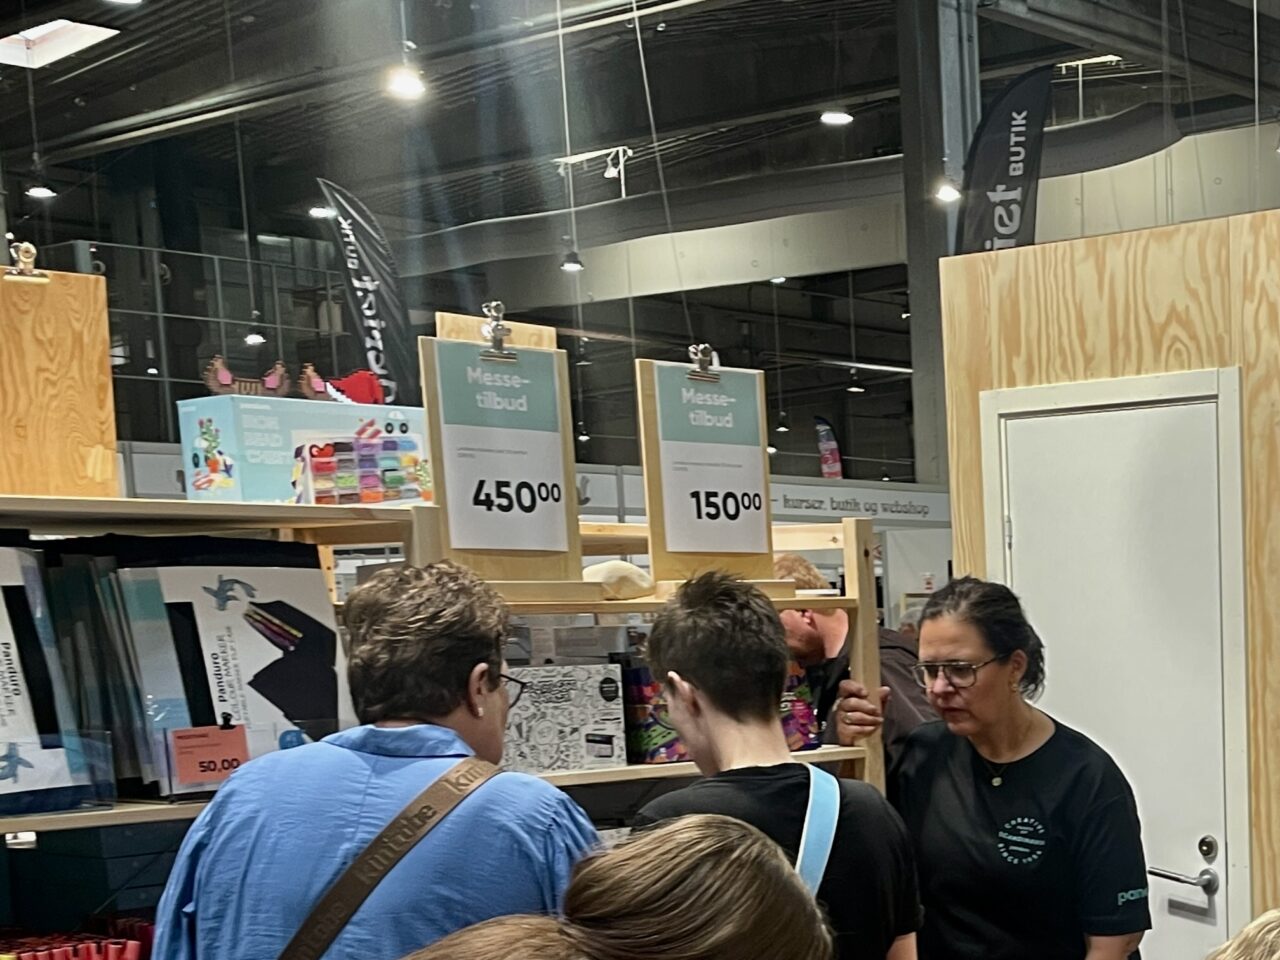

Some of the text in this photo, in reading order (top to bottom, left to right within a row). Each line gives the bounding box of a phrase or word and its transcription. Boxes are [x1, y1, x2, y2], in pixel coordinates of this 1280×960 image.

[1009, 109, 1028, 177] BUTIK
[466, 366, 531, 388] Messe-
[475, 391, 528, 412] tilbud
[681, 387, 736, 407] Messe-
[689, 410, 734, 428] tilbud
[864, 502, 878, 516] og
[881, 501, 930, 517] webshop
[1, 642, 21, 696] Panduro
[211, 652, 228, 703] Panduro
